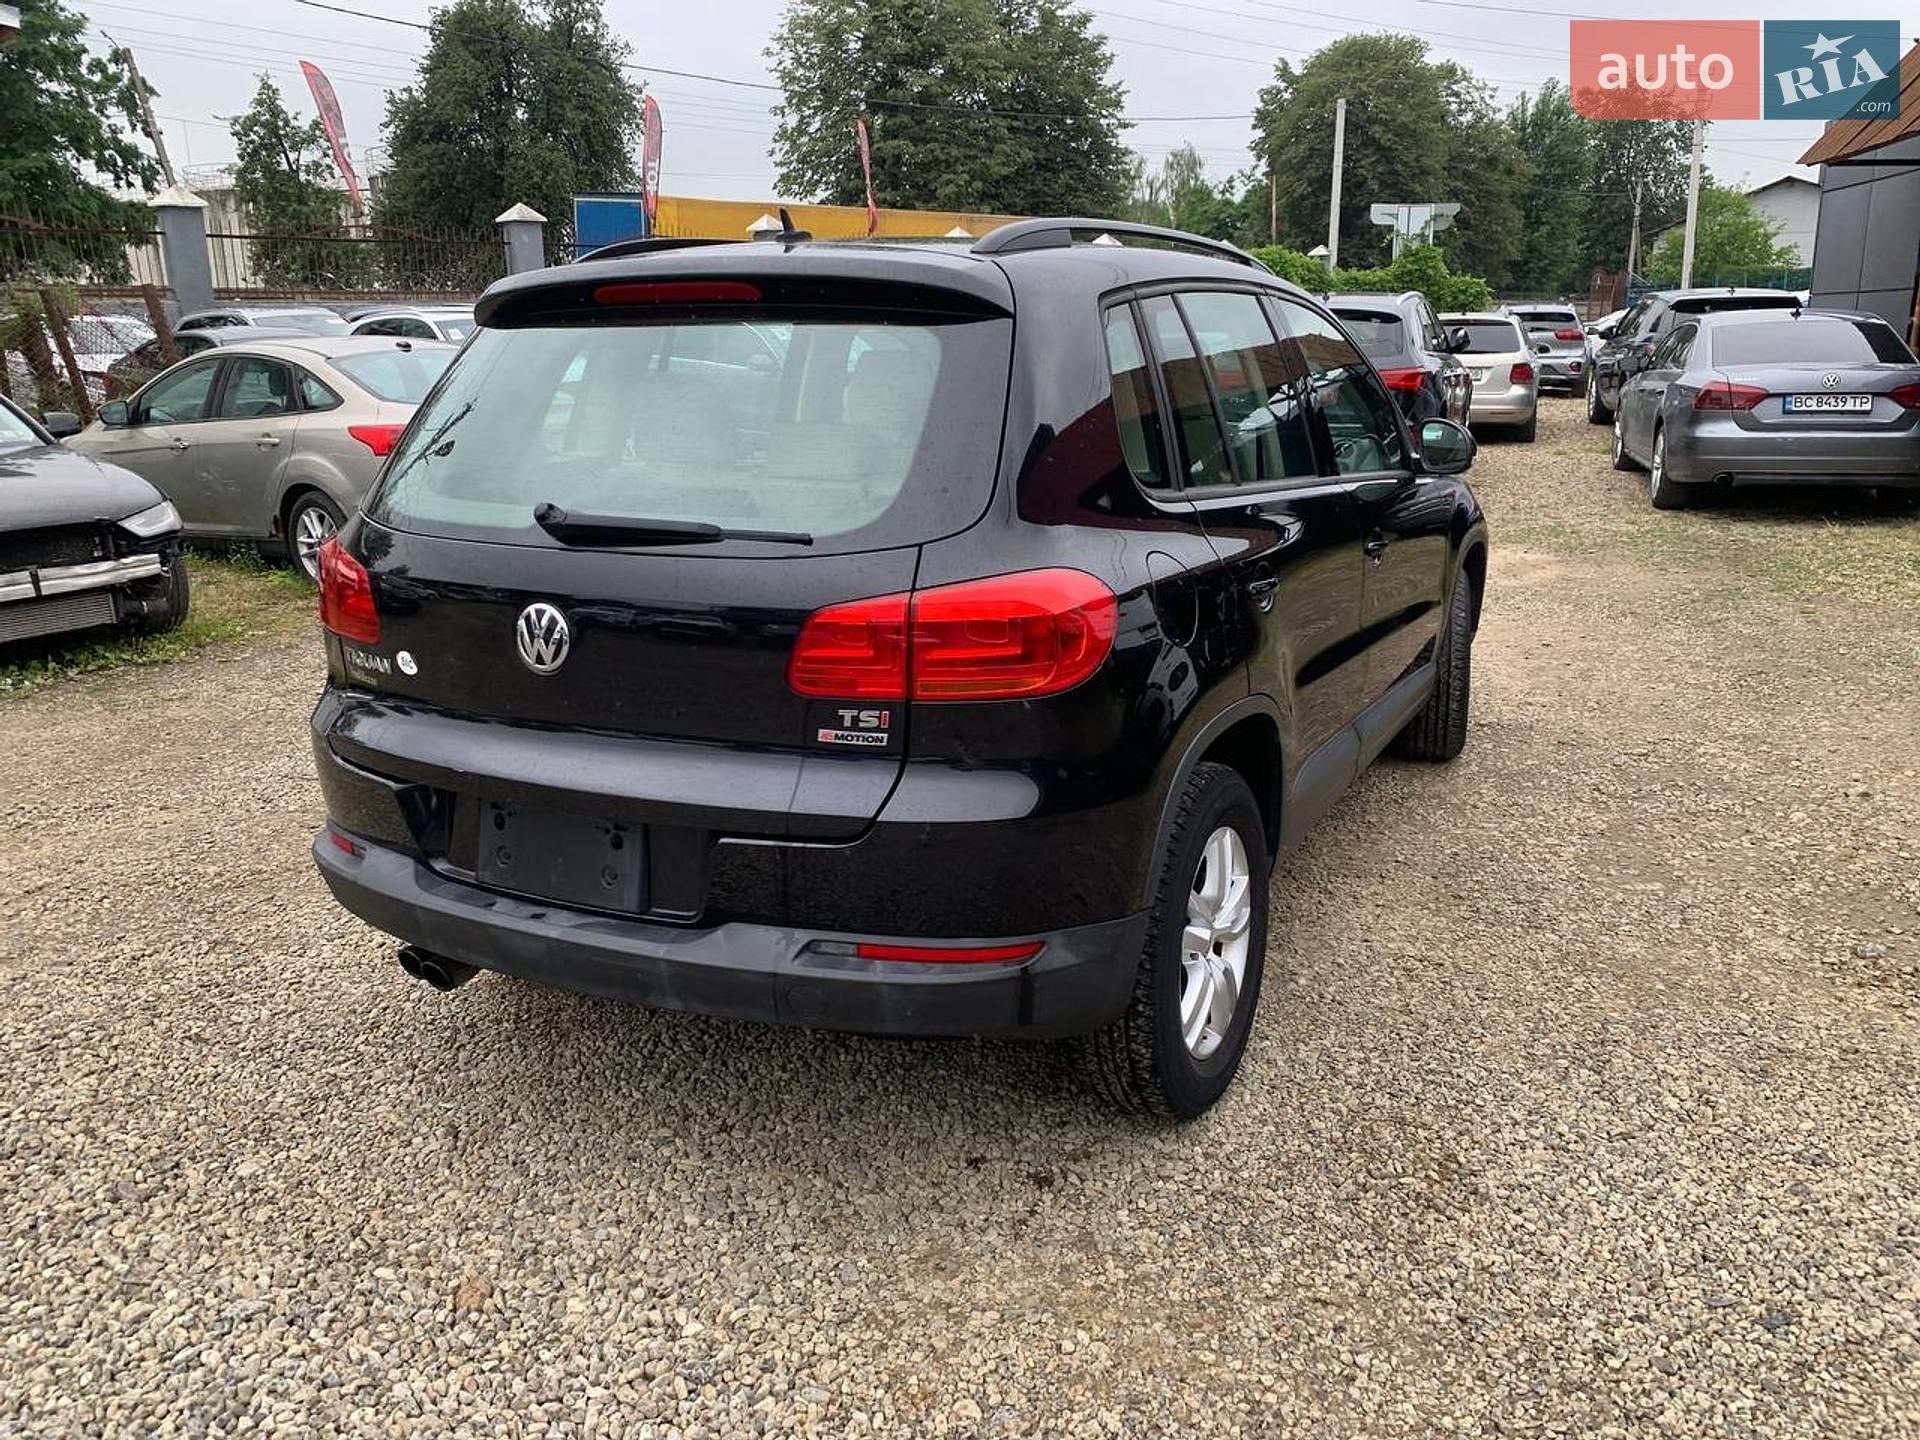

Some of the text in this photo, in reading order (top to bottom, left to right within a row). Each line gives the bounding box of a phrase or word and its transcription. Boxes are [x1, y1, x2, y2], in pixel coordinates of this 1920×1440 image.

[1793, 395, 1871, 408] BC 8439 TP
[517, 603, 569, 672] VW
